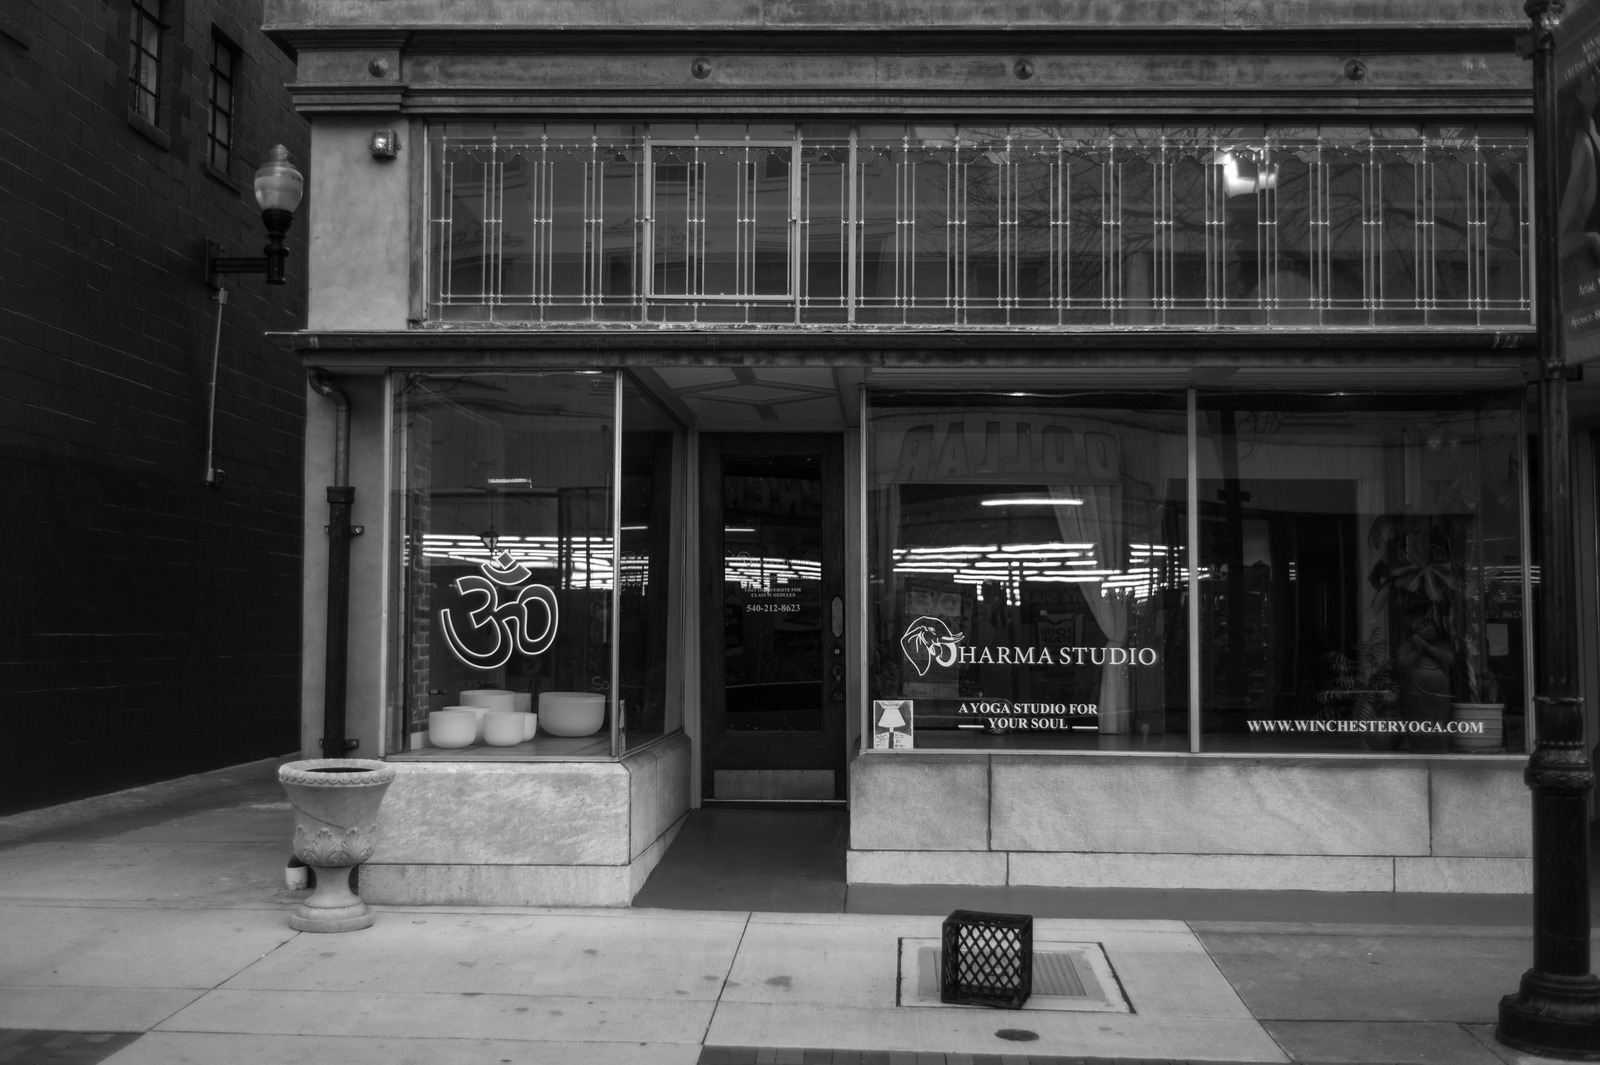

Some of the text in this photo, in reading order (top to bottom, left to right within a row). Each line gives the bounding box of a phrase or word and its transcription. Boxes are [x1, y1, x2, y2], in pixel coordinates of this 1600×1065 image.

[746, 604, 801, 613] 540-212-8623
[1059, 647, 1158, 666] STUDIO
[958, 703, 1098, 715] A YOGA STUDIO FOR
[988, 718, 1067, 729] YOUR SOUL
[1246, 720, 1484, 734] WWW.WINCHESTERYOGA.COM
